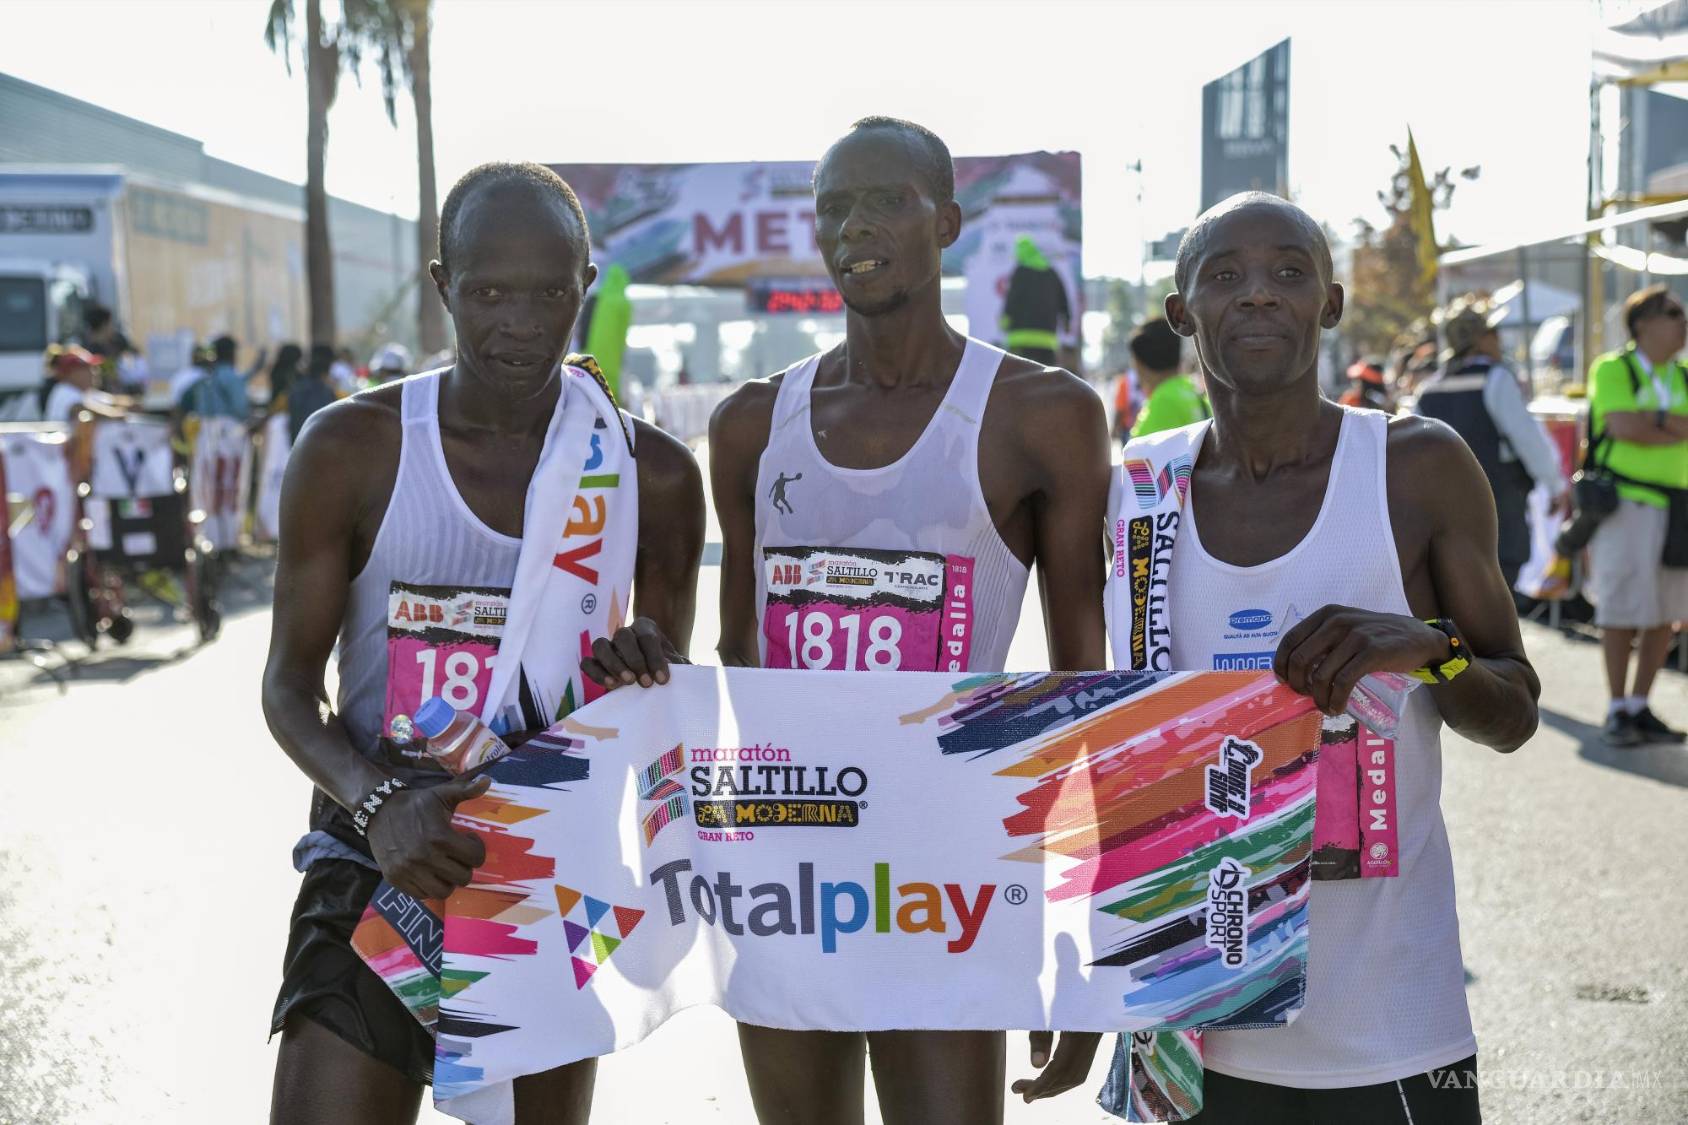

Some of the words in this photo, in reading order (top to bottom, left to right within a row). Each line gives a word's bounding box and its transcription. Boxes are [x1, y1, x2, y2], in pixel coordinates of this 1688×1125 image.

[1116, 519, 1125, 547] GRAN
[772, 564, 801, 585] ABB
[827, 566, 878, 577] SALTILLO
[394, 601, 444, 623] ABB
[785, 611, 902, 672] 1818
[690, 743, 791, 763] maratón
[691, 766, 868, 797] SALTILLO
[1368, 729, 1387, 831] Medal
[697, 804, 727, 824] LA
[697, 830, 723, 842] GRAN
[725, 830, 754, 842] RETO
[650, 858, 997, 953] Totalplay
[1210, 889, 1227, 948] SPORT
[1226, 890, 1243, 965] CHRONO
